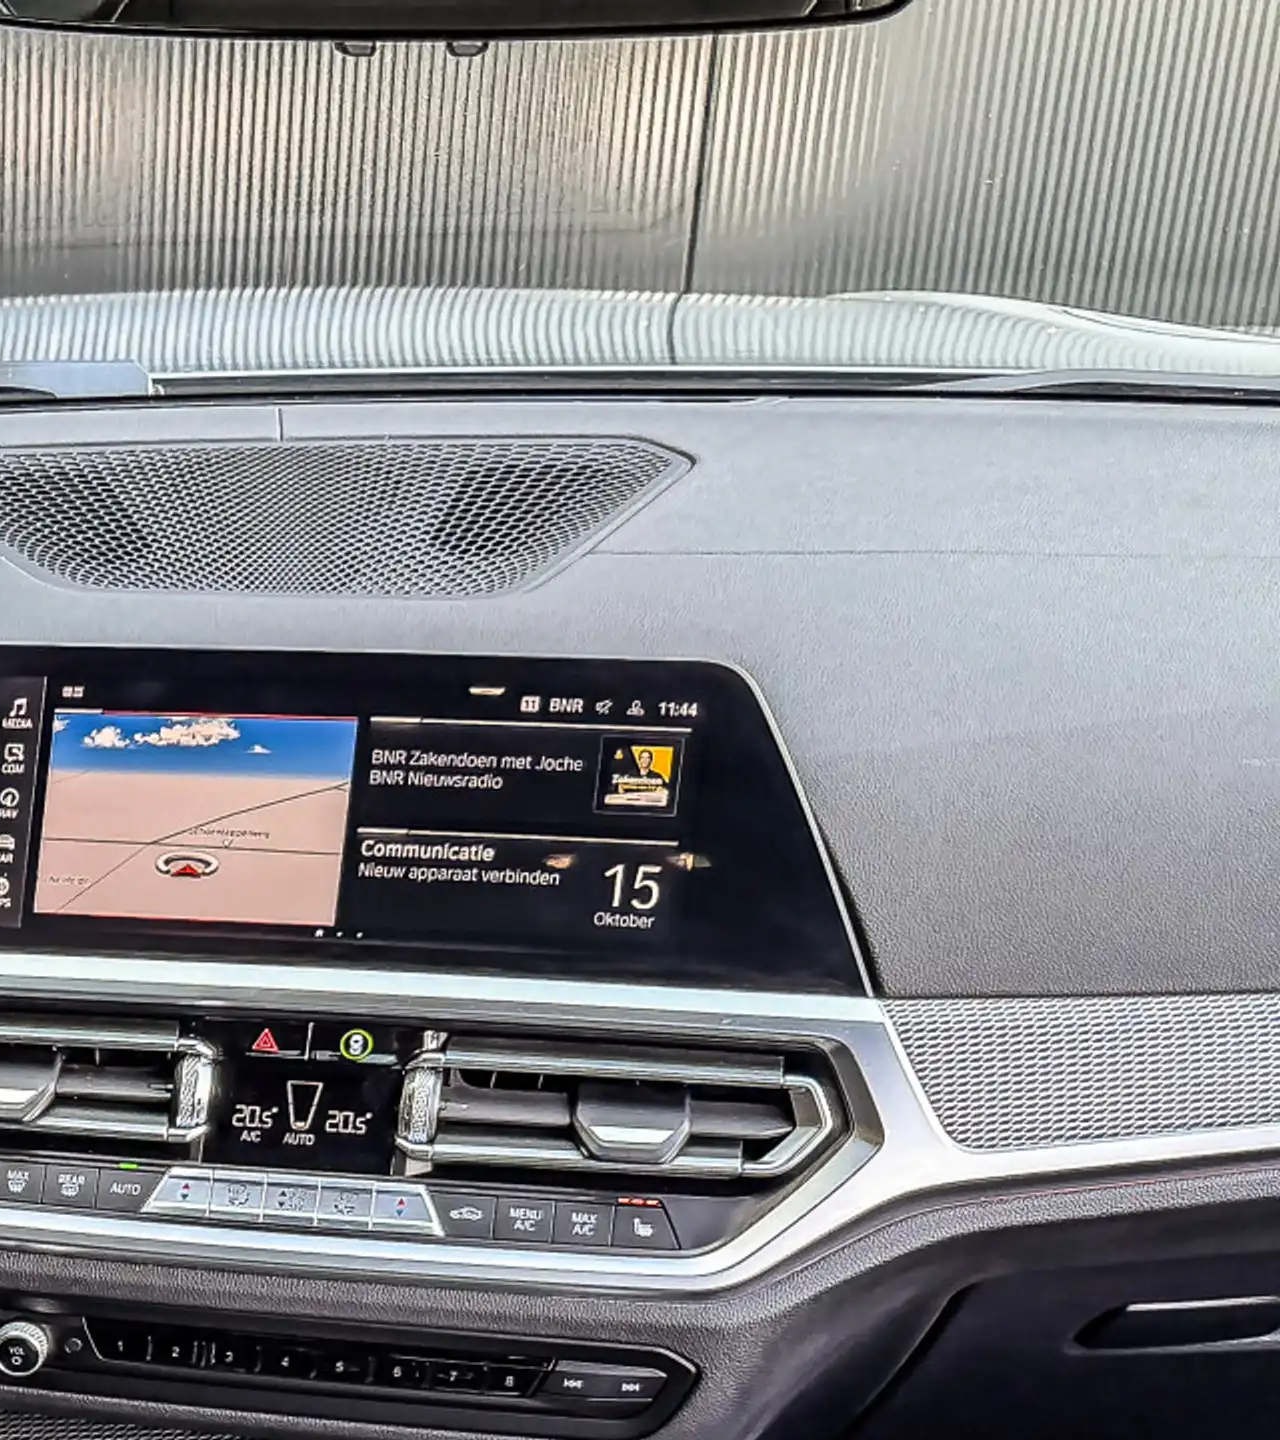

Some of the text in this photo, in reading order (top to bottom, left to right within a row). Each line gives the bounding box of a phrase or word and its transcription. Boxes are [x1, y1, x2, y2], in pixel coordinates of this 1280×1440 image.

[549, 698, 583, 713] BNR
[659, 702, 698, 716] 11:44
[2, 718, 33, 728] MEDIA
[371, 750, 406, 765] BNR
[410, 751, 497, 769] Zakendoen
[501, 755, 531, 770] met
[1, 763, 25, 774] COM
[370, 770, 503, 789] BNR Nieuwsradio
[361, 840, 496, 862] Communicatie
[358, 863, 560, 886] Nieuw apparaat verbinden
[604, 864, 663, 910] 15
[593, 911, 655, 929] Oktober
[240, 1130, 261, 1142] A/C
[282, 1133, 315, 1145] AUTO
[7, 1169, 30, 1180] MAX
[58, 1174, 85, 1184] REAR
[110, 1182, 141, 1195] AUTO
[509, 1207, 541, 1220] MENU
[571, 1211, 598, 1223] MAX
[514, 1219, 536, 1231] A/C
[572, 1222, 595, 1235] A/C
[8, 1346, 25, 1356] VOL
[171, 1346, 180, 1358] 2
[224, 1351, 234, 1363] 3
